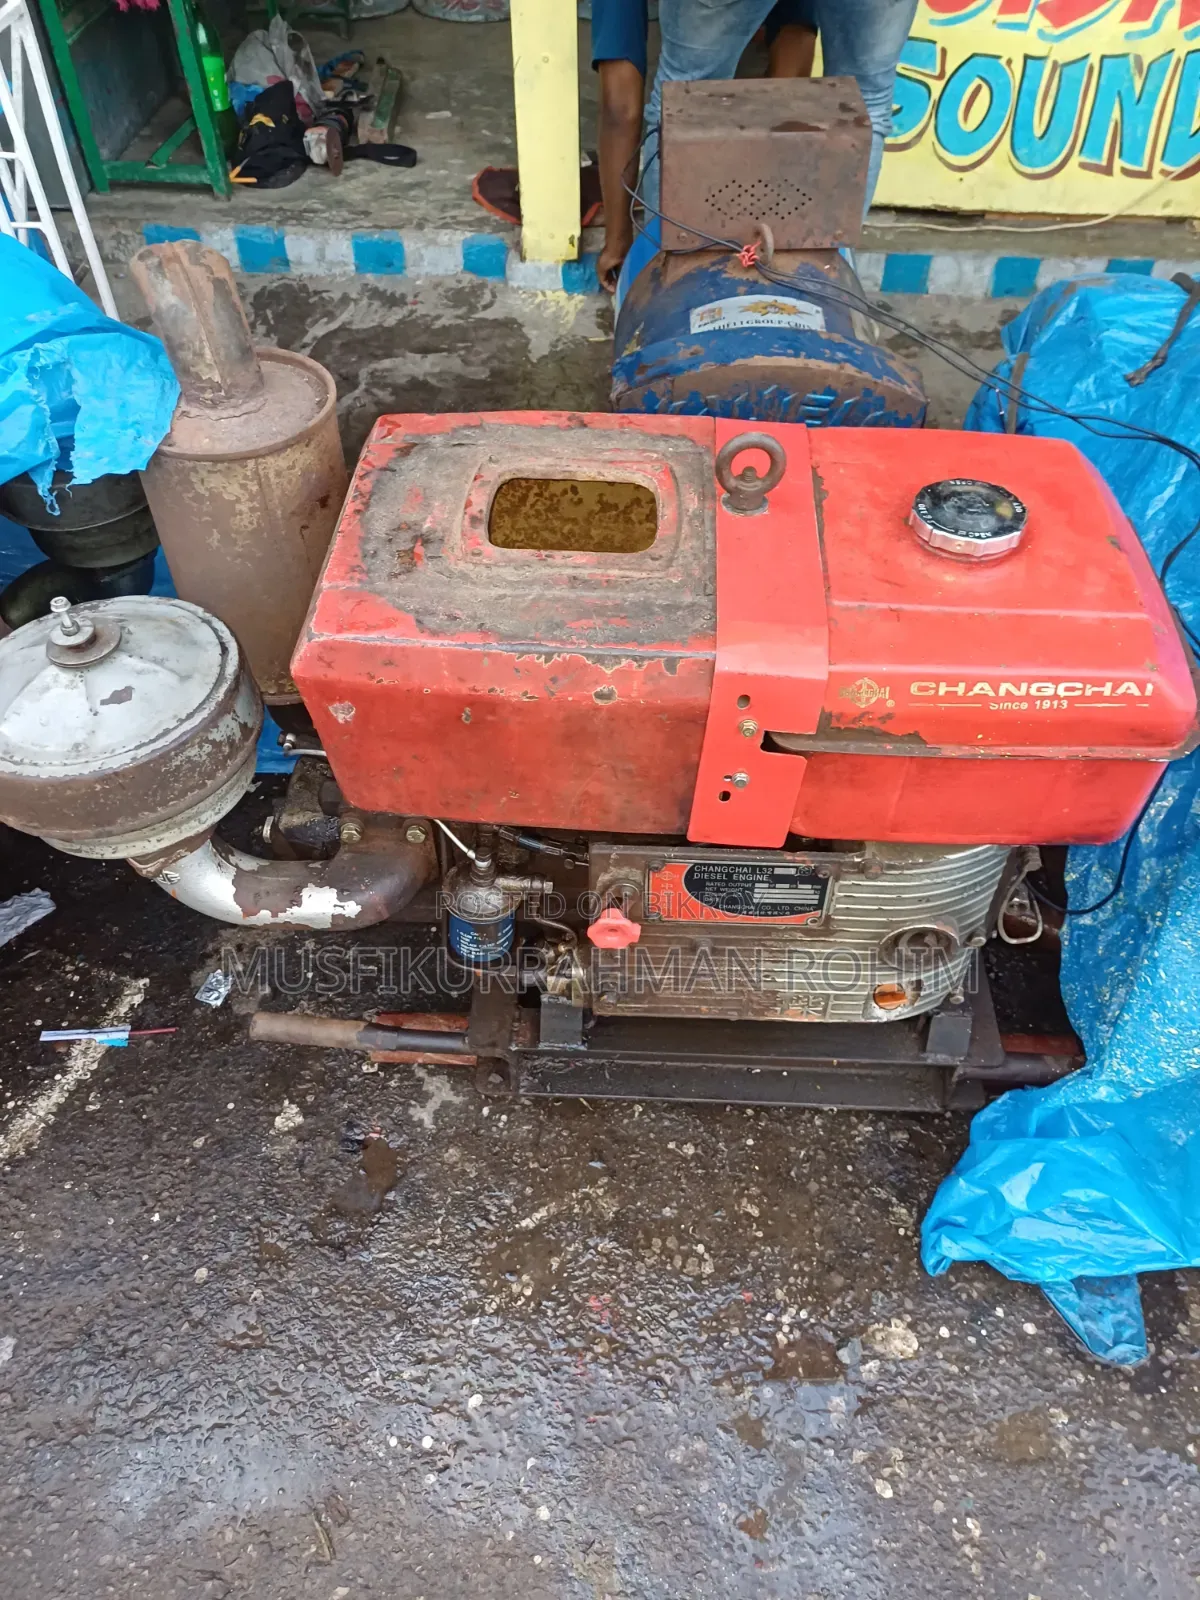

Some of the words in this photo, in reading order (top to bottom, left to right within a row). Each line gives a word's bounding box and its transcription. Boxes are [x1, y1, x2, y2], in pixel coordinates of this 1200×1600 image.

[909, 681, 1154, 697] CHANGCHAI
[989, 700, 1028, 711] Since
[1034, 700, 1068, 710] 1913
[694, 865, 752, 874] CHANGCHAI
[756, 867, 773, 875] L32
[694, 872, 728, 880] DIESEL
[733, 873, 770, 881] ENGINE
